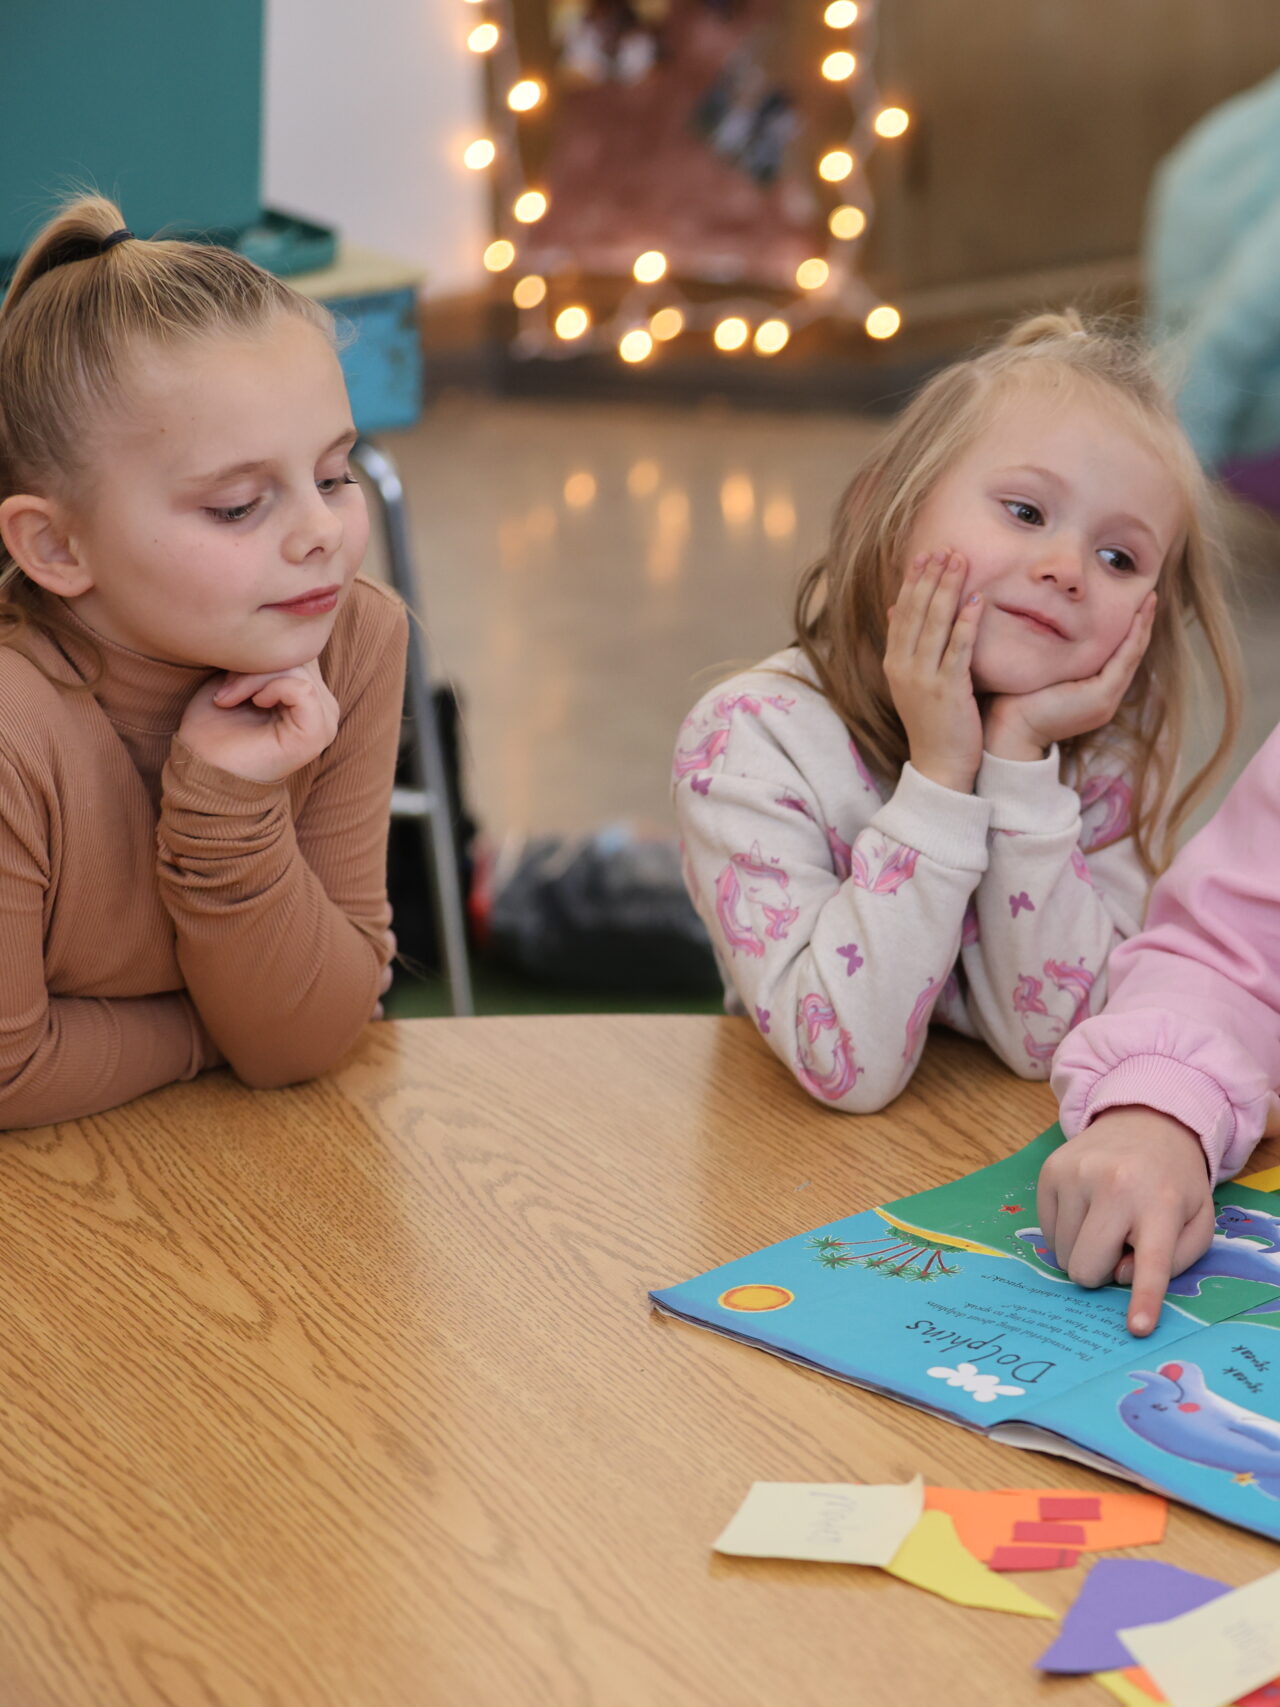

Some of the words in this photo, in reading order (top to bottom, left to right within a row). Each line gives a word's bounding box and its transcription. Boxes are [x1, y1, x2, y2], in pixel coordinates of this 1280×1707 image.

[905, 1319, 1056, 1384] Dolphins
[1231, 1345, 1271, 1372] squeak
[1222, 1366, 1264, 1393] squeak
